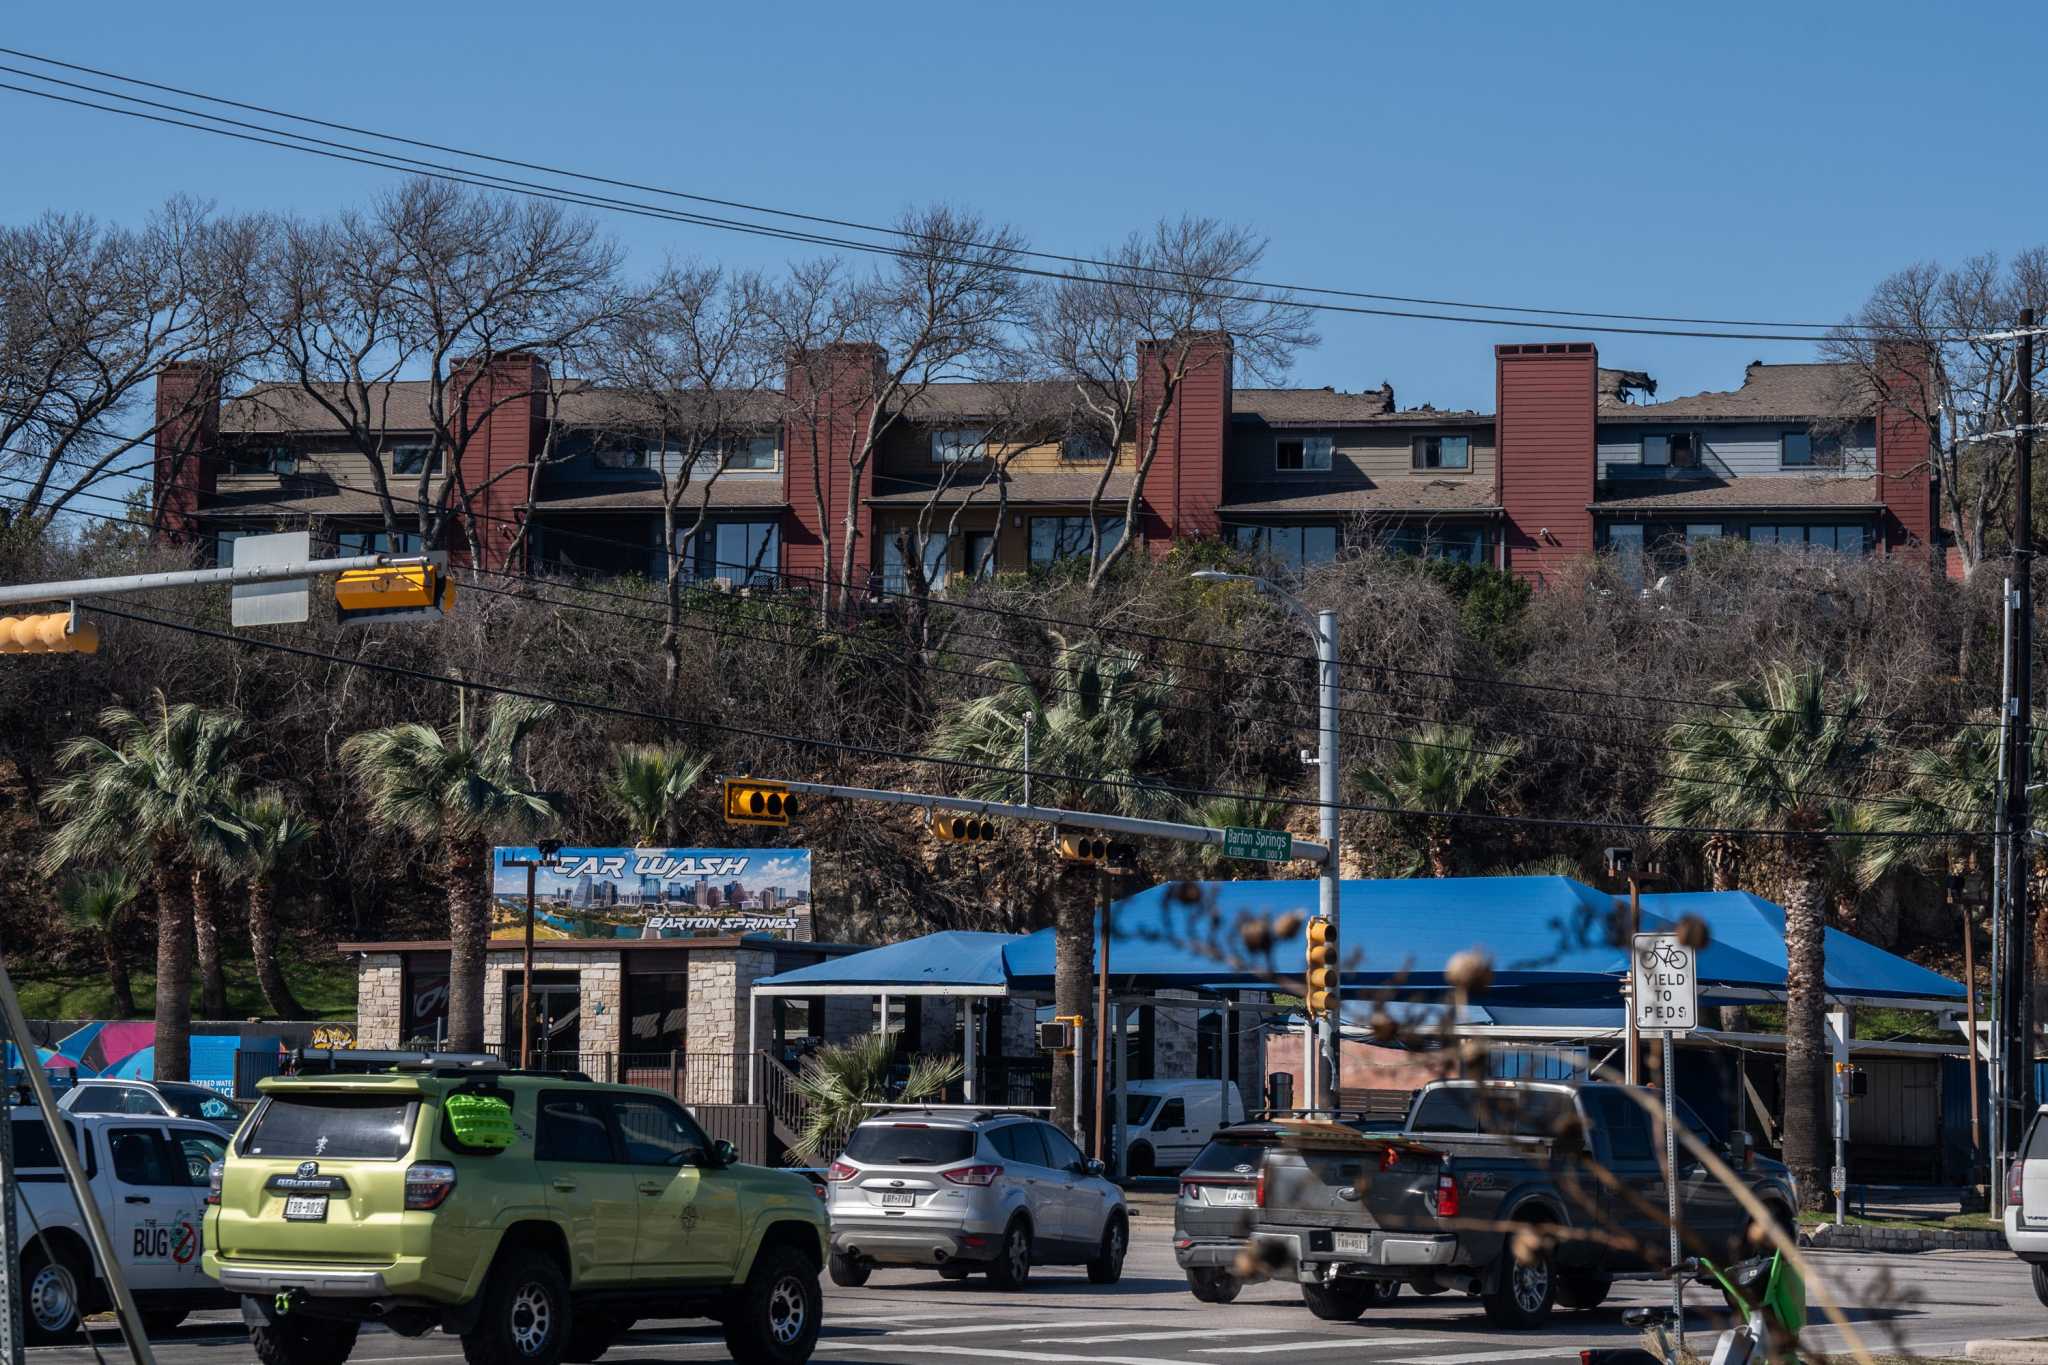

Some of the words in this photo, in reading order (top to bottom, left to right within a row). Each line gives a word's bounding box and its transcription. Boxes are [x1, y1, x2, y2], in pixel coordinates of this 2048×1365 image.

[1228, 829, 1253, 845] Barton
[1255, 831, 1287, 850] Springs
[553, 856, 627, 879] CAR
[634, 856, 749, 879] WASH
[647, 916, 720, 931] BARTON
[721, 917, 800, 930] SPRINGS
[1644, 973, 1685, 986] YIELD
[1654, 990, 1672, 1002] TO
[1644, 1006, 1686, 1019] PEDS
[144, 1218, 157, 1228] THE
[134, 1228, 168, 1257] BUG
